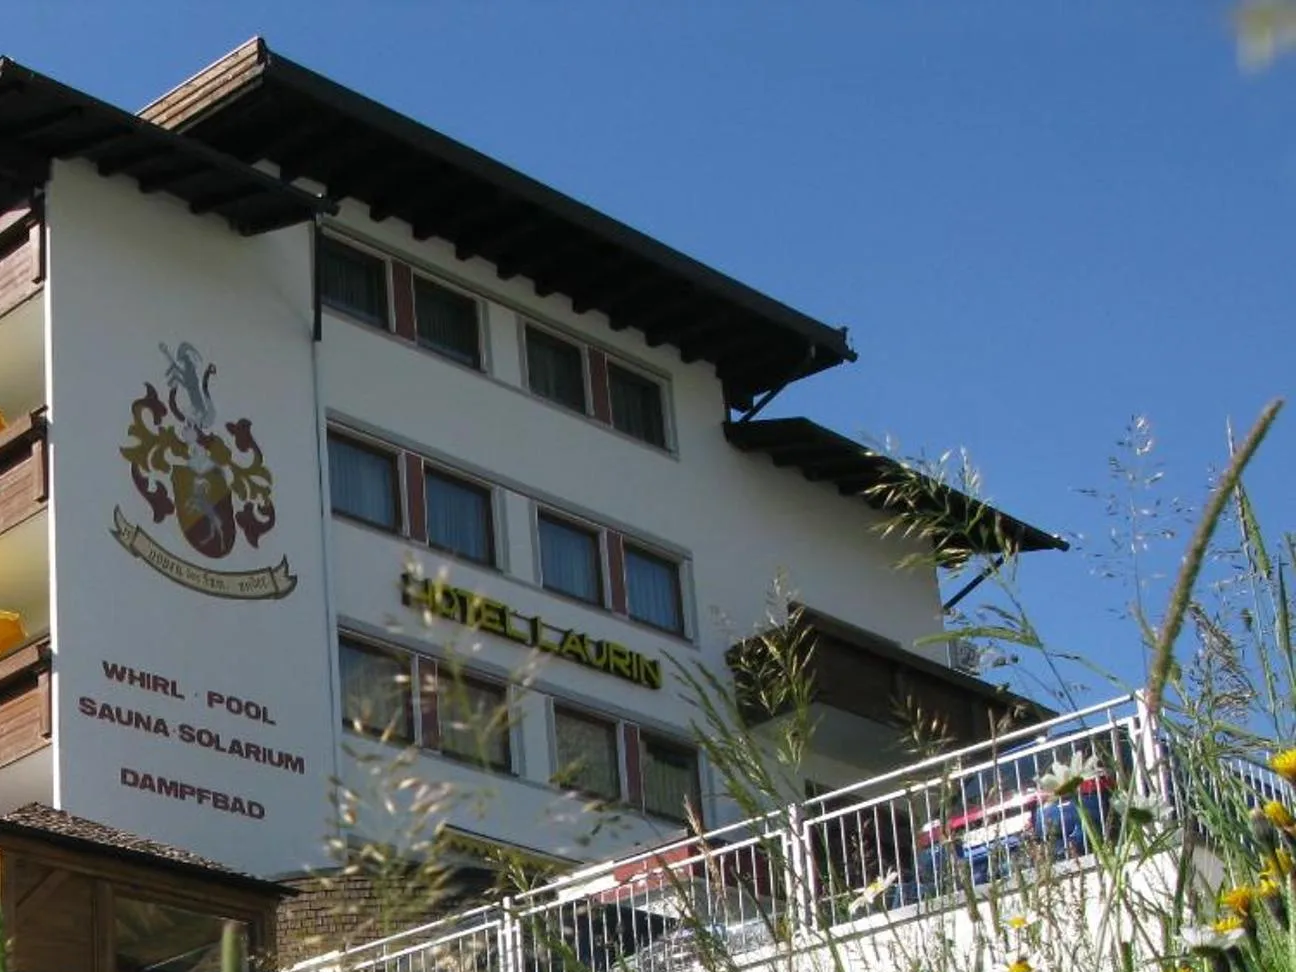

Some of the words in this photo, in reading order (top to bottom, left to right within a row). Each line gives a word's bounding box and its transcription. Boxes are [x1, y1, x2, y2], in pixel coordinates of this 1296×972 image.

[529, 615, 664, 690] LAURIN
[102, 660, 186, 700] WHIRL
[206, 689, 277, 726] POOL
[78, 695, 171, 738] SAUNA
[178, 722, 305, 775] SOLARIUM
[120, 766, 266, 820] DAMPFBAD
